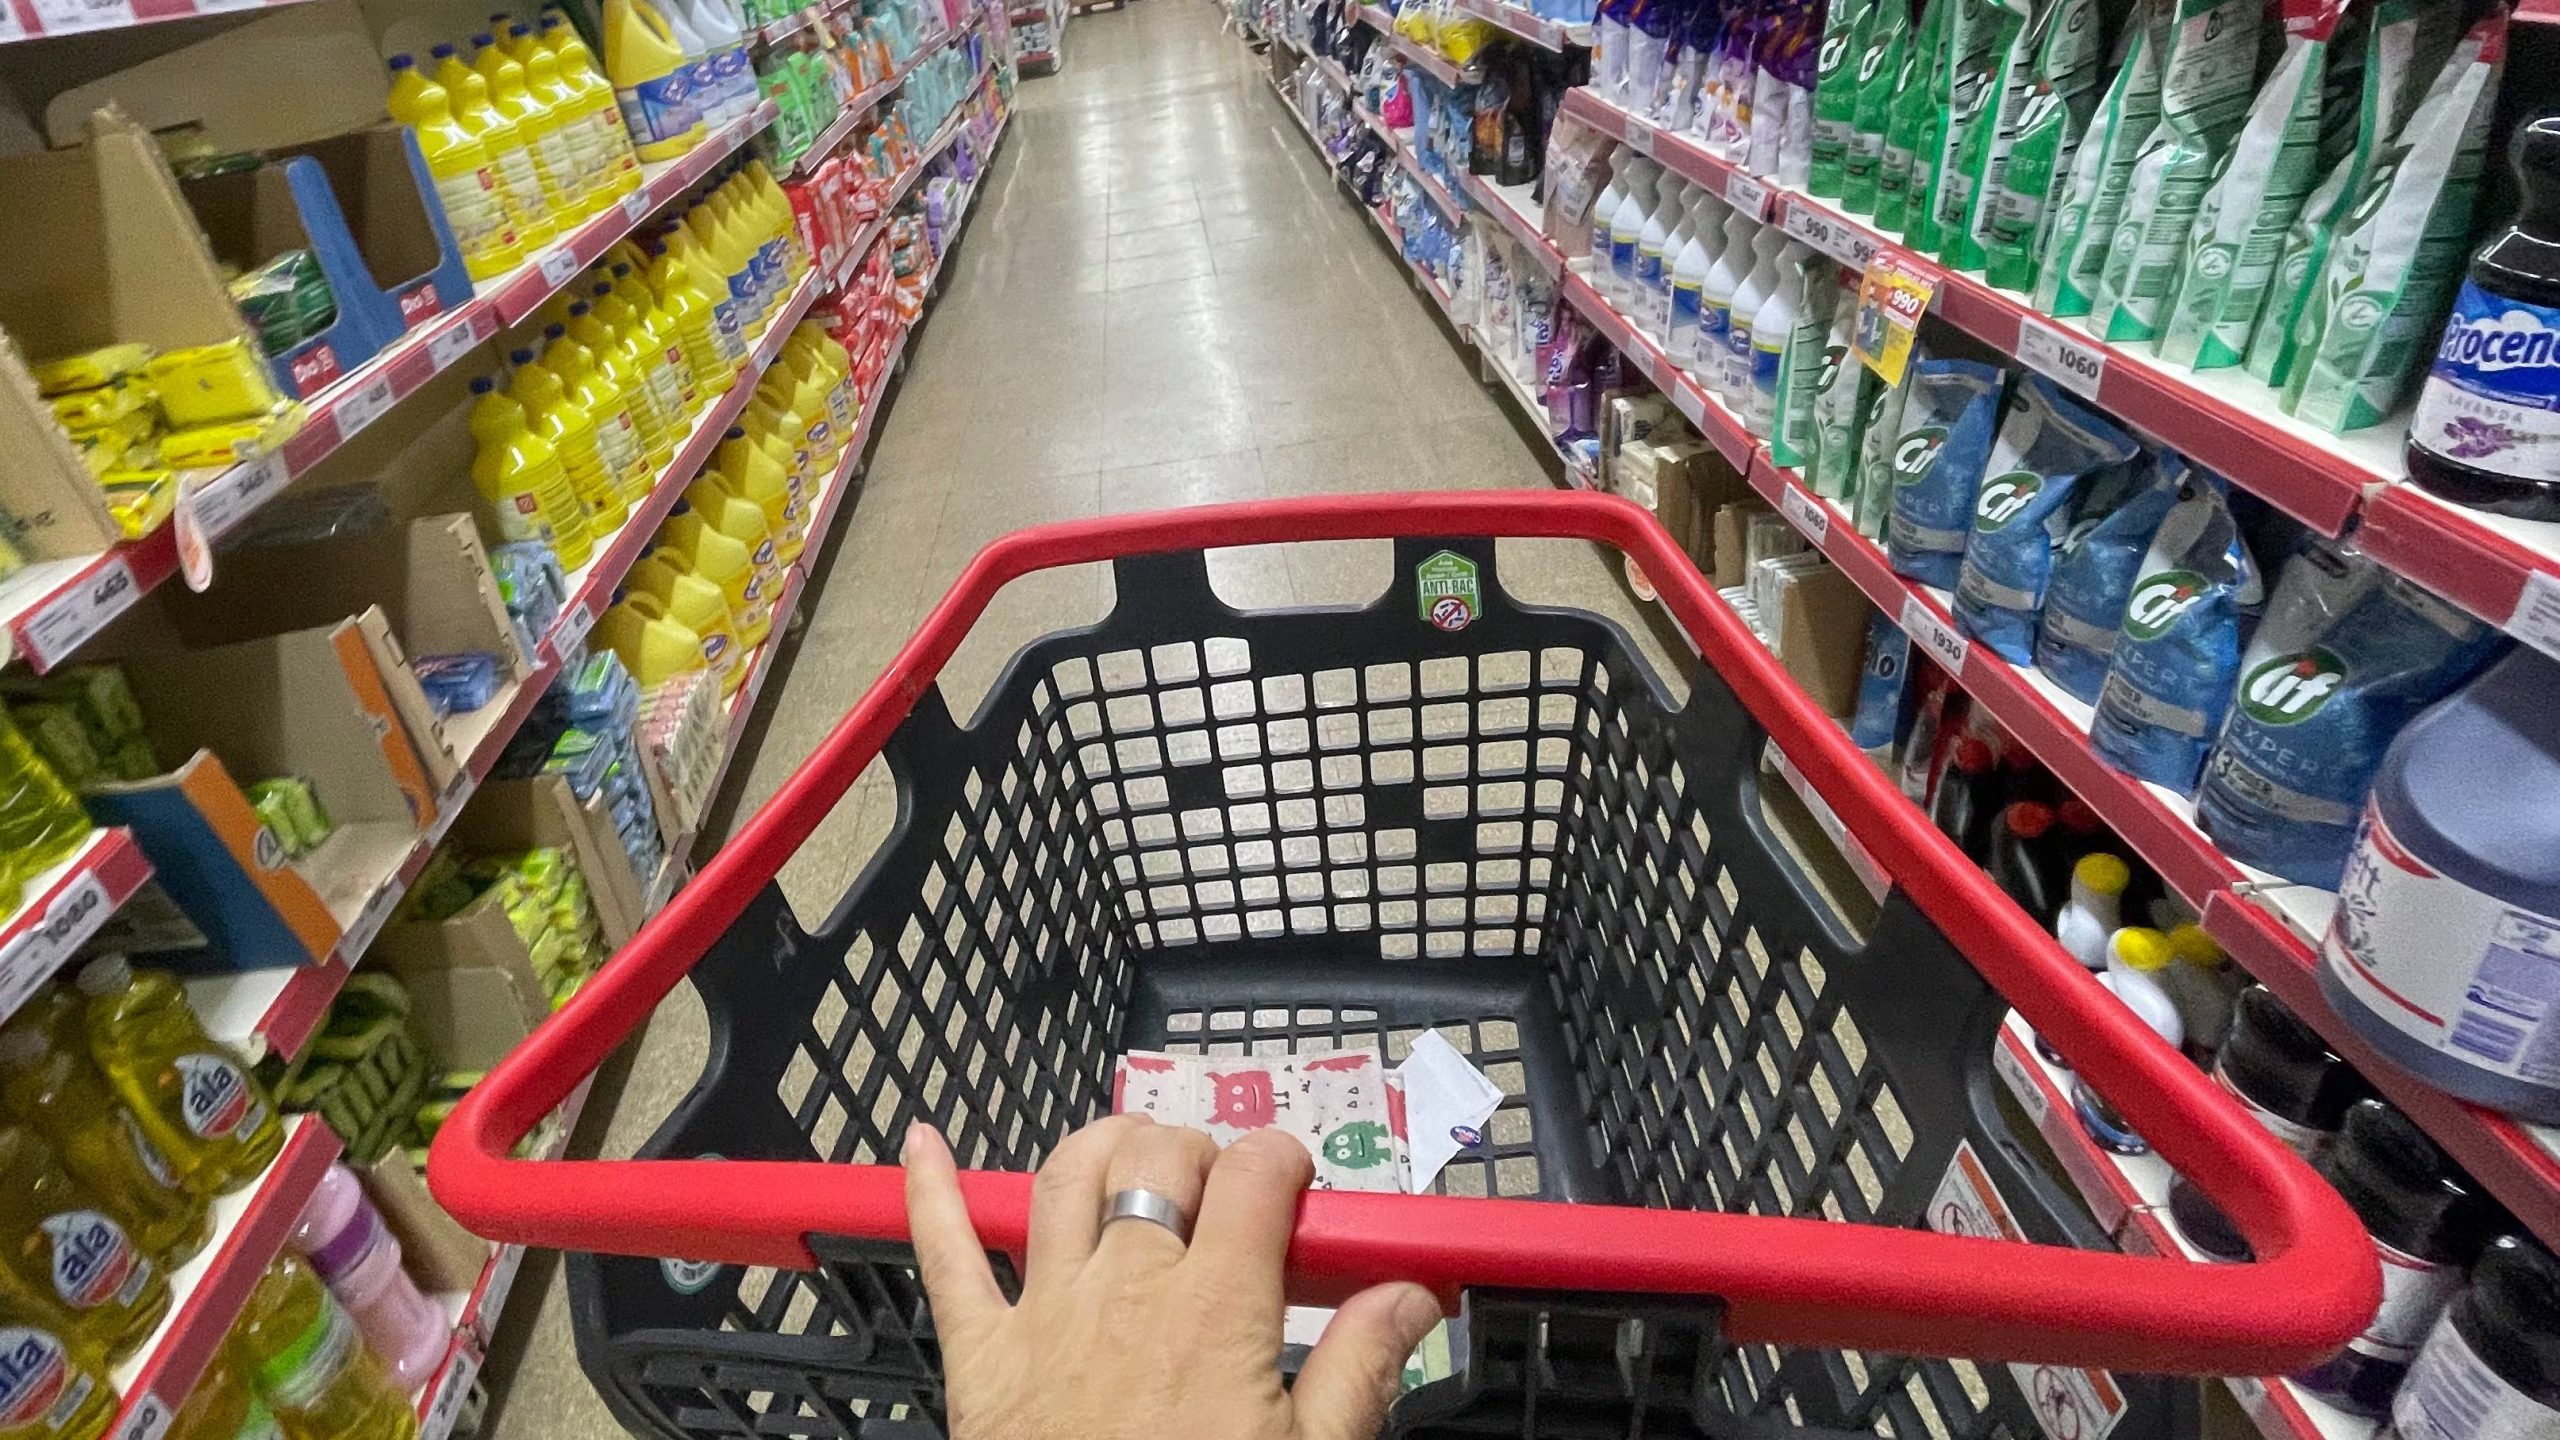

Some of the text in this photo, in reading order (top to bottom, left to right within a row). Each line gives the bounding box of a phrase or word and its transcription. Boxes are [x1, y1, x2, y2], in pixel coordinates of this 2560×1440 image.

[1853, 241, 1876, 263] 99
[2059, 346, 2098, 379] 1060
[1978, 483, 2037, 523] Cif
[2130, 583, 2201, 629] Cif
[1934, 628, 1961, 660] 1930
[2250, 662, 2342, 714] Cif
